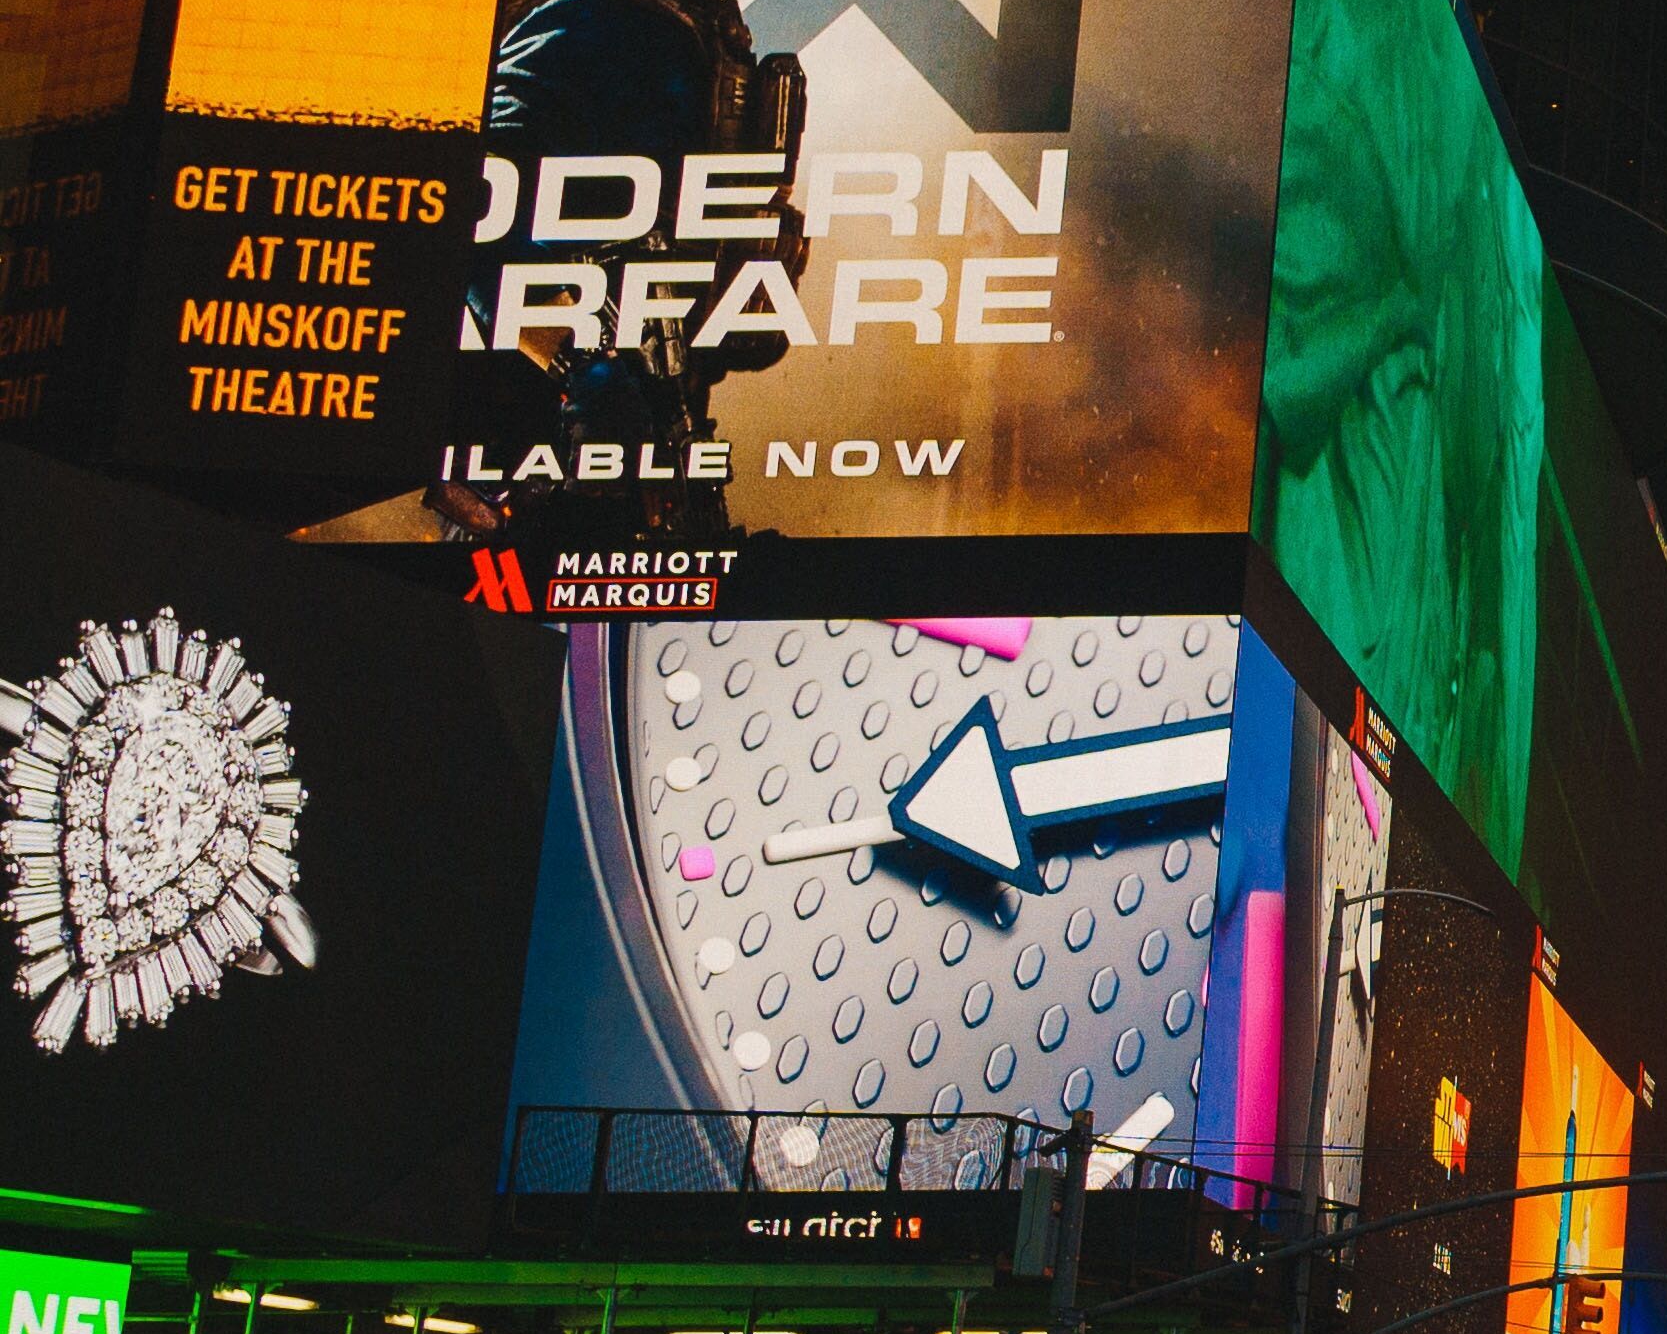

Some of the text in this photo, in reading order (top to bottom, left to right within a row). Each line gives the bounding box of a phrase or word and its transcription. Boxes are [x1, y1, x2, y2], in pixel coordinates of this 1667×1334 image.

[174, 166, 447, 223] GET TICKETS
[227, 236, 375, 286] AT THE
[178, 298, 406, 353] MINSKOFF
[459, 256, 1058, 350] RFARE
[189, 367, 379, 419] THEATRE
[764, 439, 967, 478] NOW
[556, 551, 739, 575] MARRIOTT
[551, 581, 712, 608] MARQUIS
